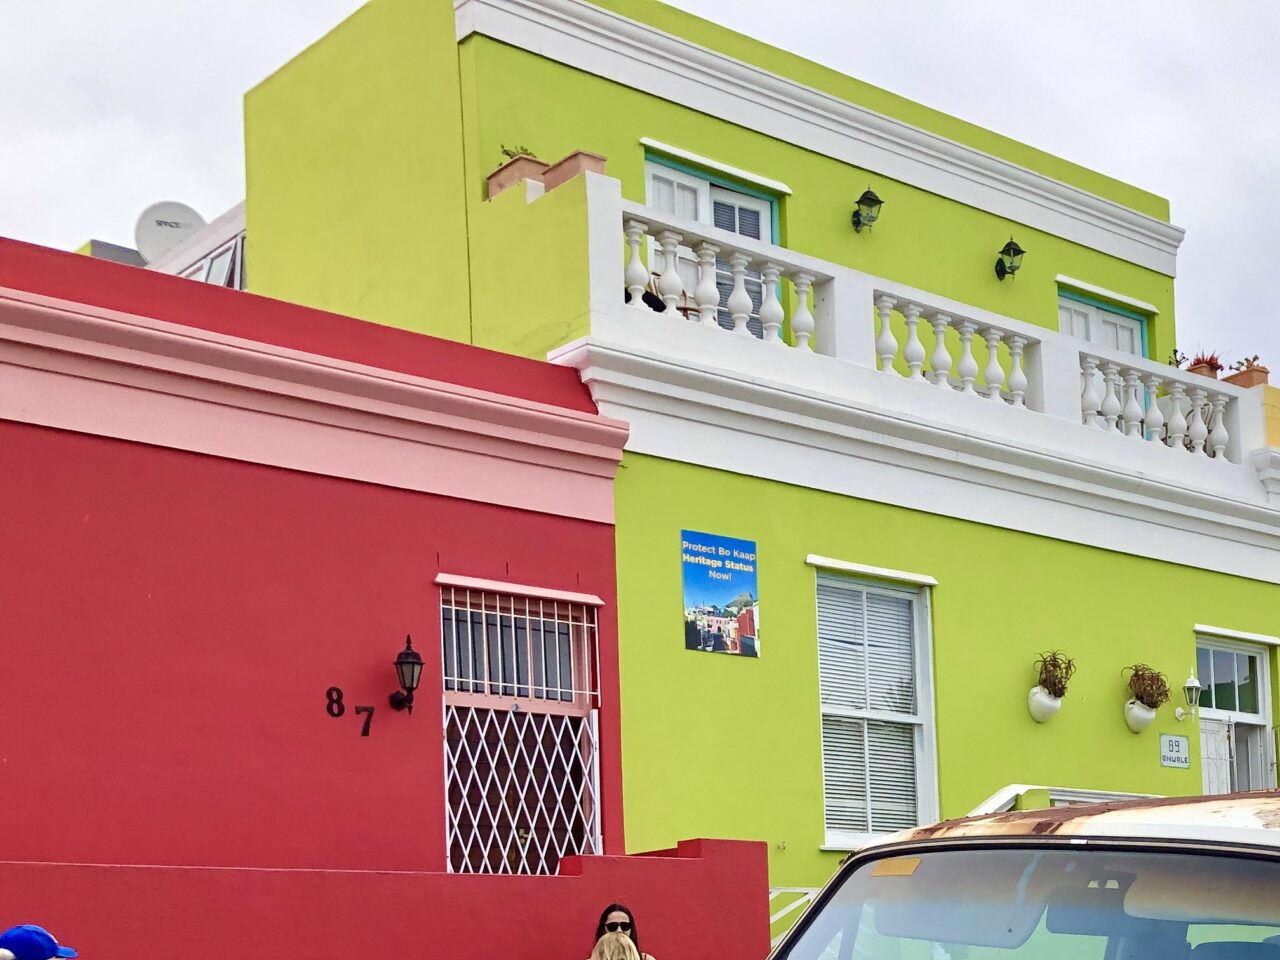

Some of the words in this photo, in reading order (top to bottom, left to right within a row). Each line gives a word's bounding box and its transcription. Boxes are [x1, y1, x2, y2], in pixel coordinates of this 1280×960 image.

[682, 541, 715, 555] Protect
[718, 546, 731, 556] Bo
[733, 549, 756, 562] Kaap
[682, 554, 722, 568] Heritage
[725, 561, 754, 572] Status
[708, 570, 732, 581] Now!
[1168, 739, 1180, 753] 89
